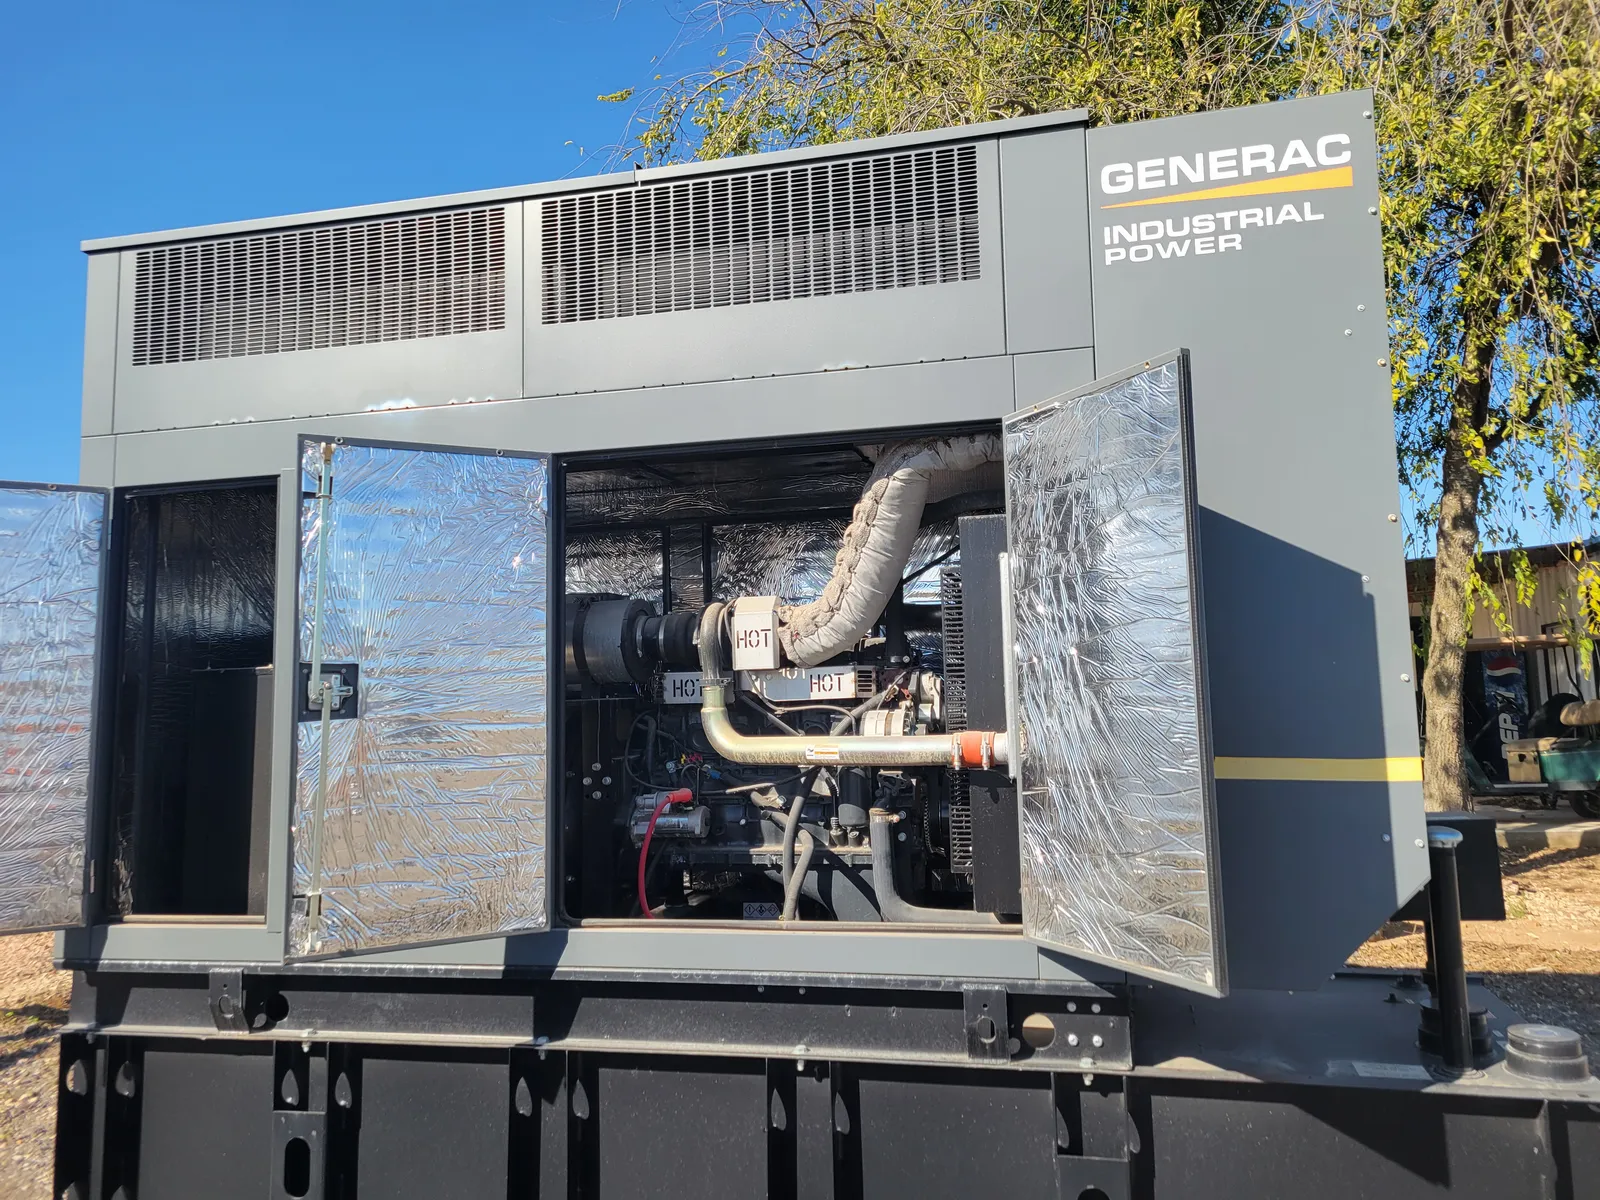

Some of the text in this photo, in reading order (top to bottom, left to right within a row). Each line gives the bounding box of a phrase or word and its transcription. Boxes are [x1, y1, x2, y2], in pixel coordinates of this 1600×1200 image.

[1100, 133, 1352, 195] GENERAC
[1103, 201, 1325, 246] INDUSTRIAL
[1104, 233, 1243, 266] POWER
[736, 628, 772, 649] HOT
[809, 672, 845, 693] HOT
